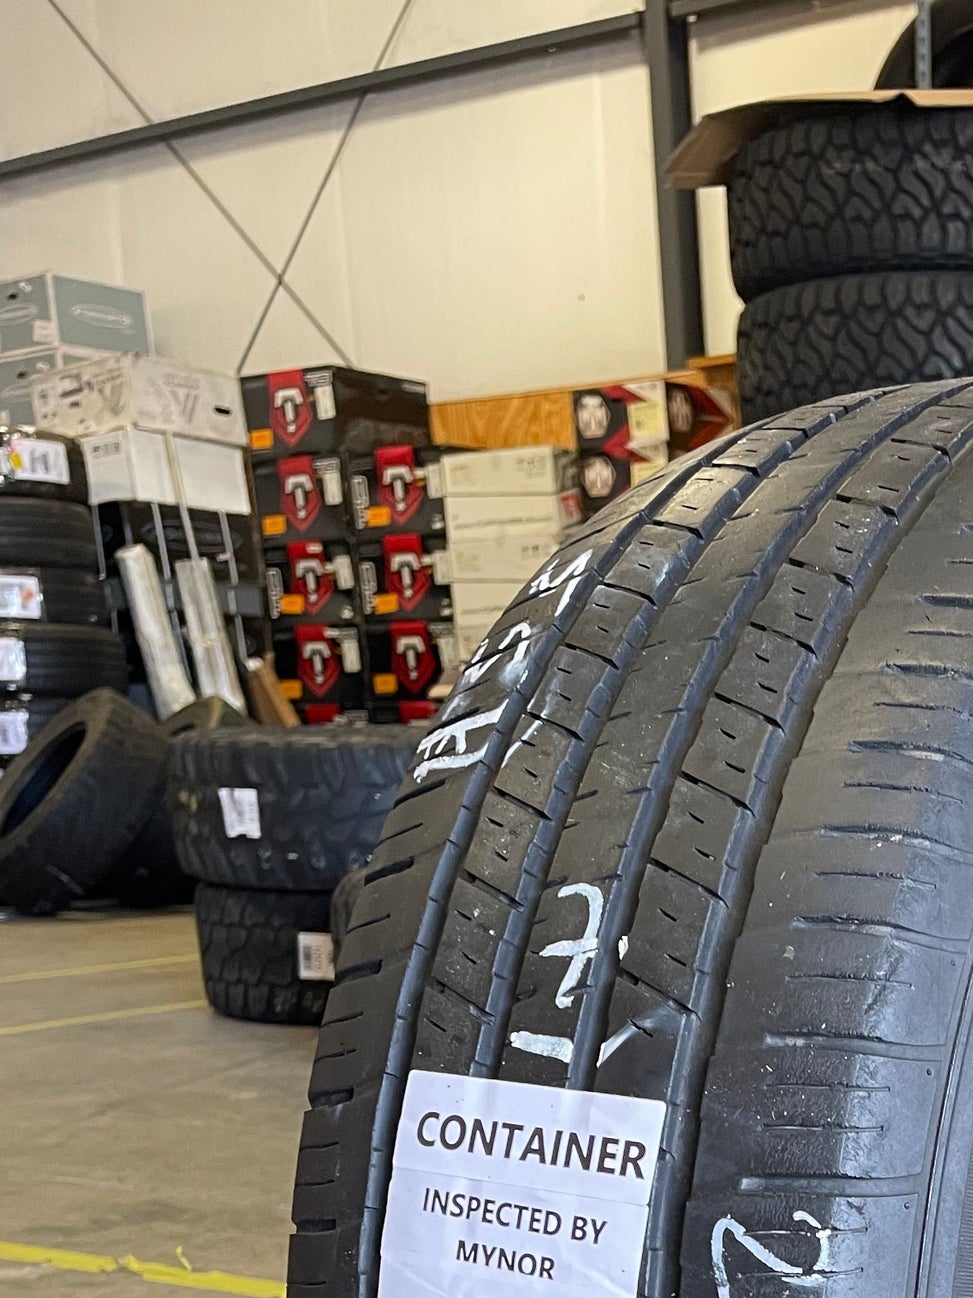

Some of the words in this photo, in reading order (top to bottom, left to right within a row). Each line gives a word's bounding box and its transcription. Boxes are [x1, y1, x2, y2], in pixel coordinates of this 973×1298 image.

[416, 1110, 647, 1181] CONTAINER
[422, 1187, 562, 1237] INSPECTED
[571, 1214, 609, 1246] BY
[455, 1239, 556, 1281] MYNOR
